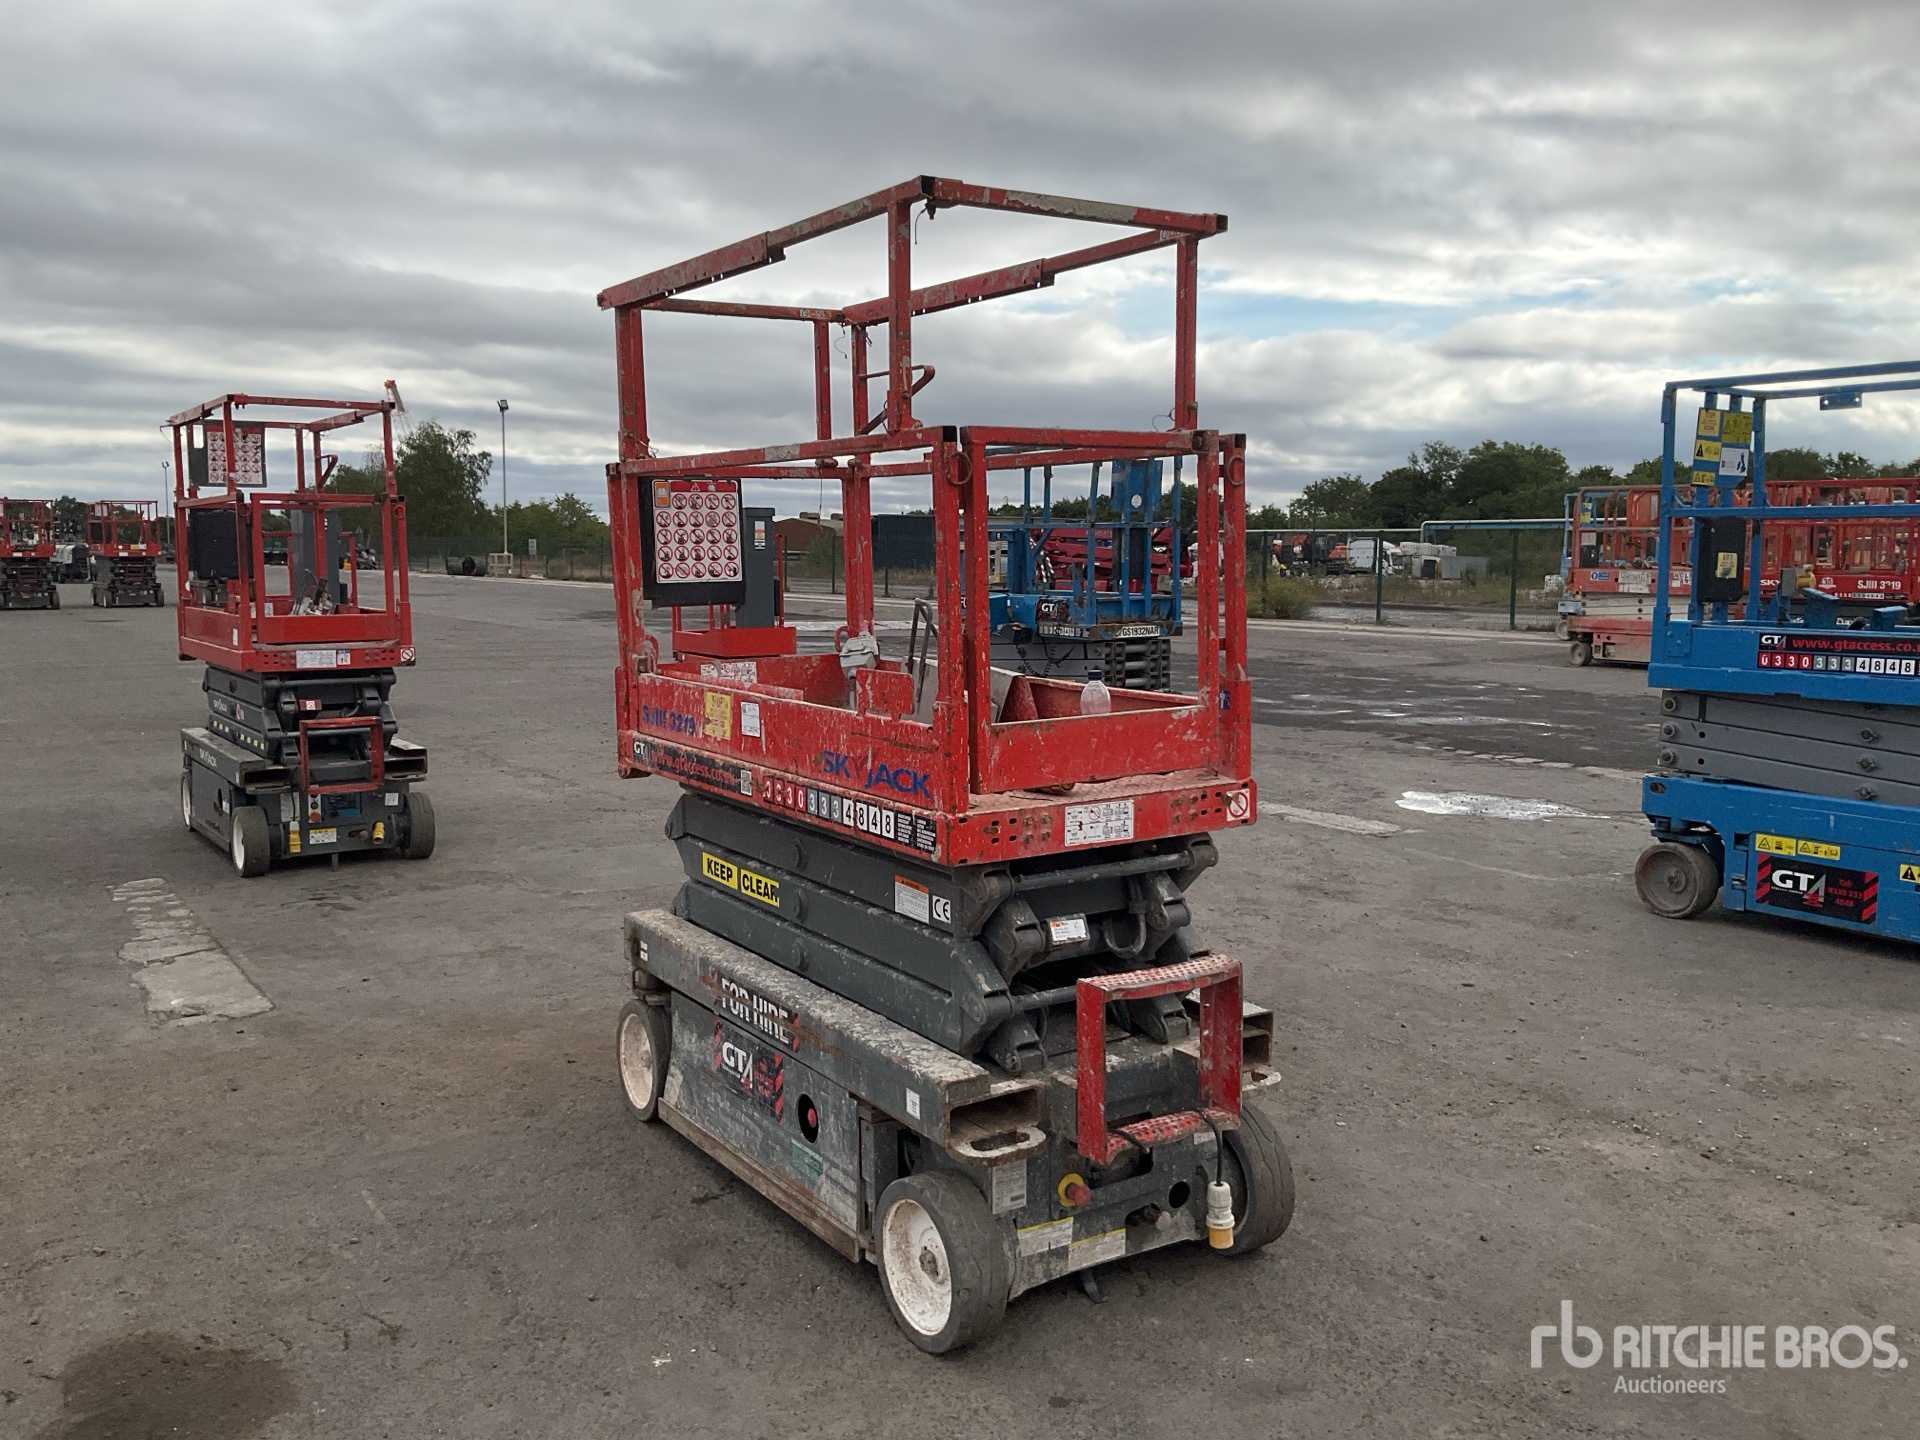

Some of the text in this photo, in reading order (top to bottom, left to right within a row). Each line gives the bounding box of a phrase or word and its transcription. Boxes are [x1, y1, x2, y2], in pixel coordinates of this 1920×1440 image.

[706, 857, 733, 883] KEEP
[934, 898, 949, 921] CE
[721, 978, 790, 1045] FOR HIRE
